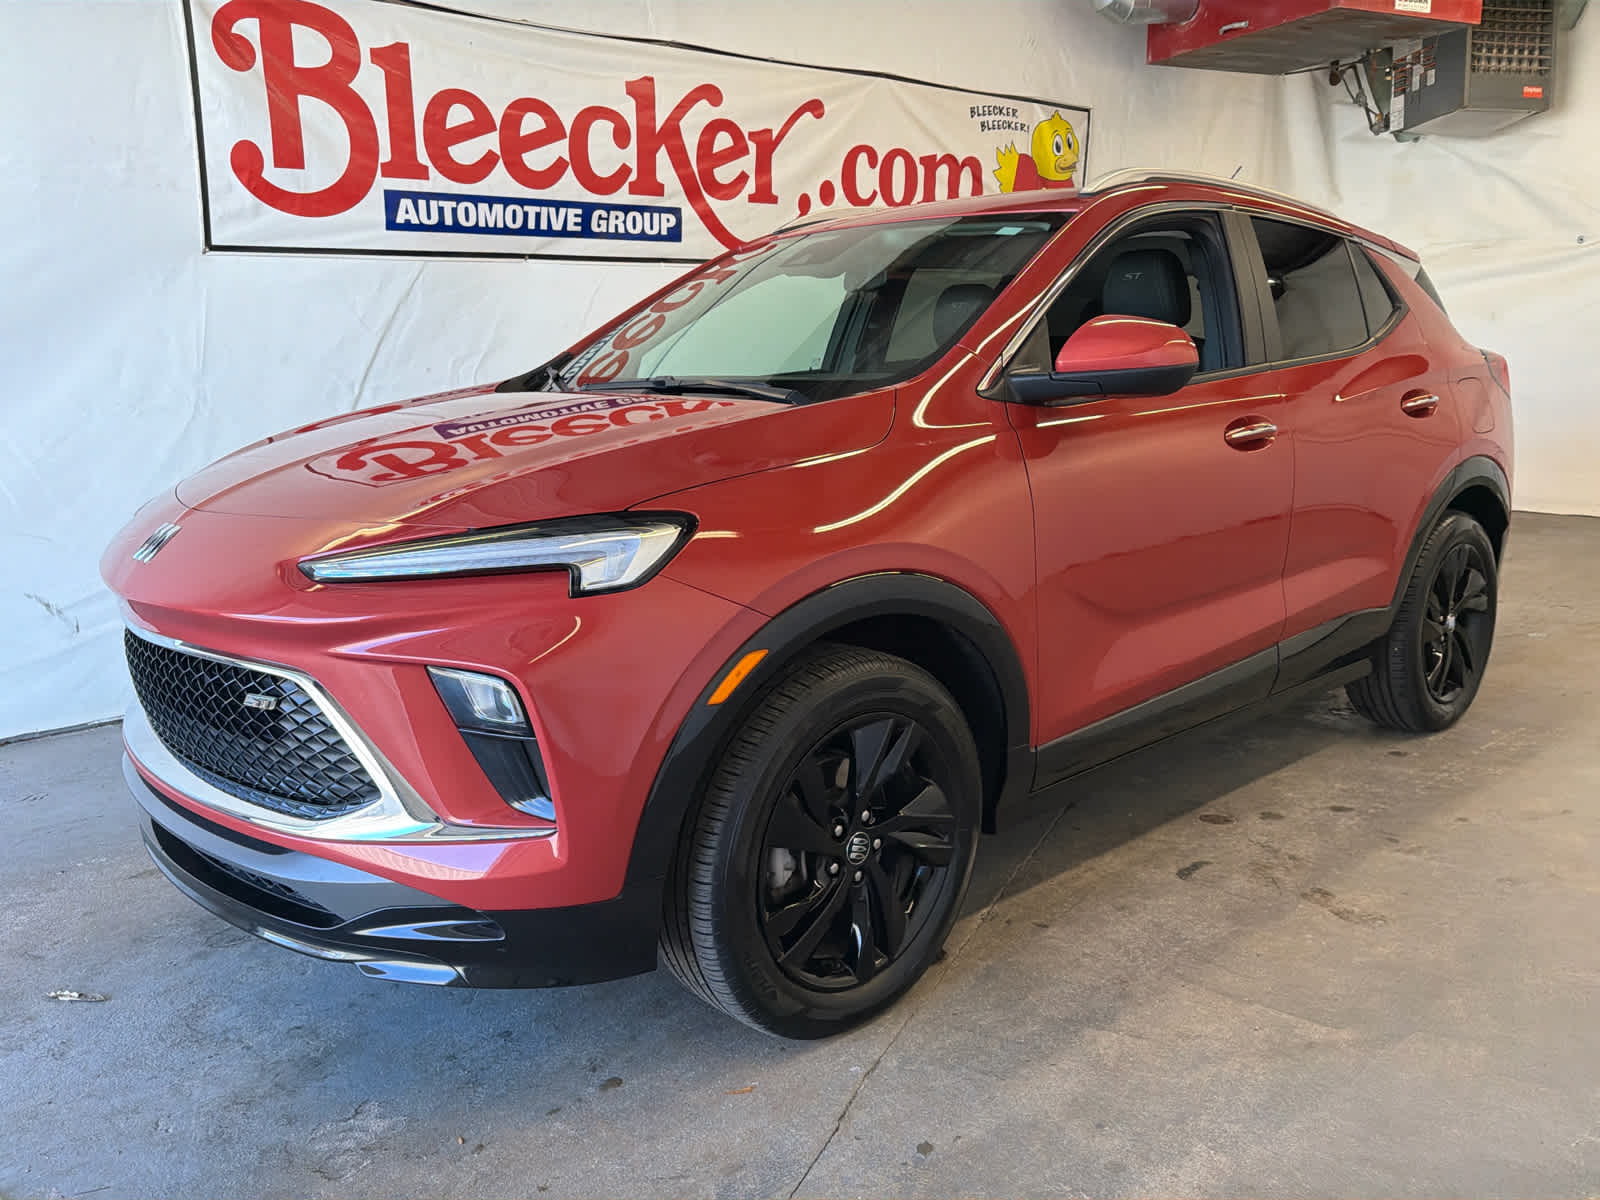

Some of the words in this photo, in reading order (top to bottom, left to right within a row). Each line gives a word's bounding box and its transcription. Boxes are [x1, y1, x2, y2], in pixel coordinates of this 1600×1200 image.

[970, 105, 1018, 119] BLEECKER
[395, 197, 582, 233] AUTOMOTIVE
[590, 209, 677, 236] GROUP
